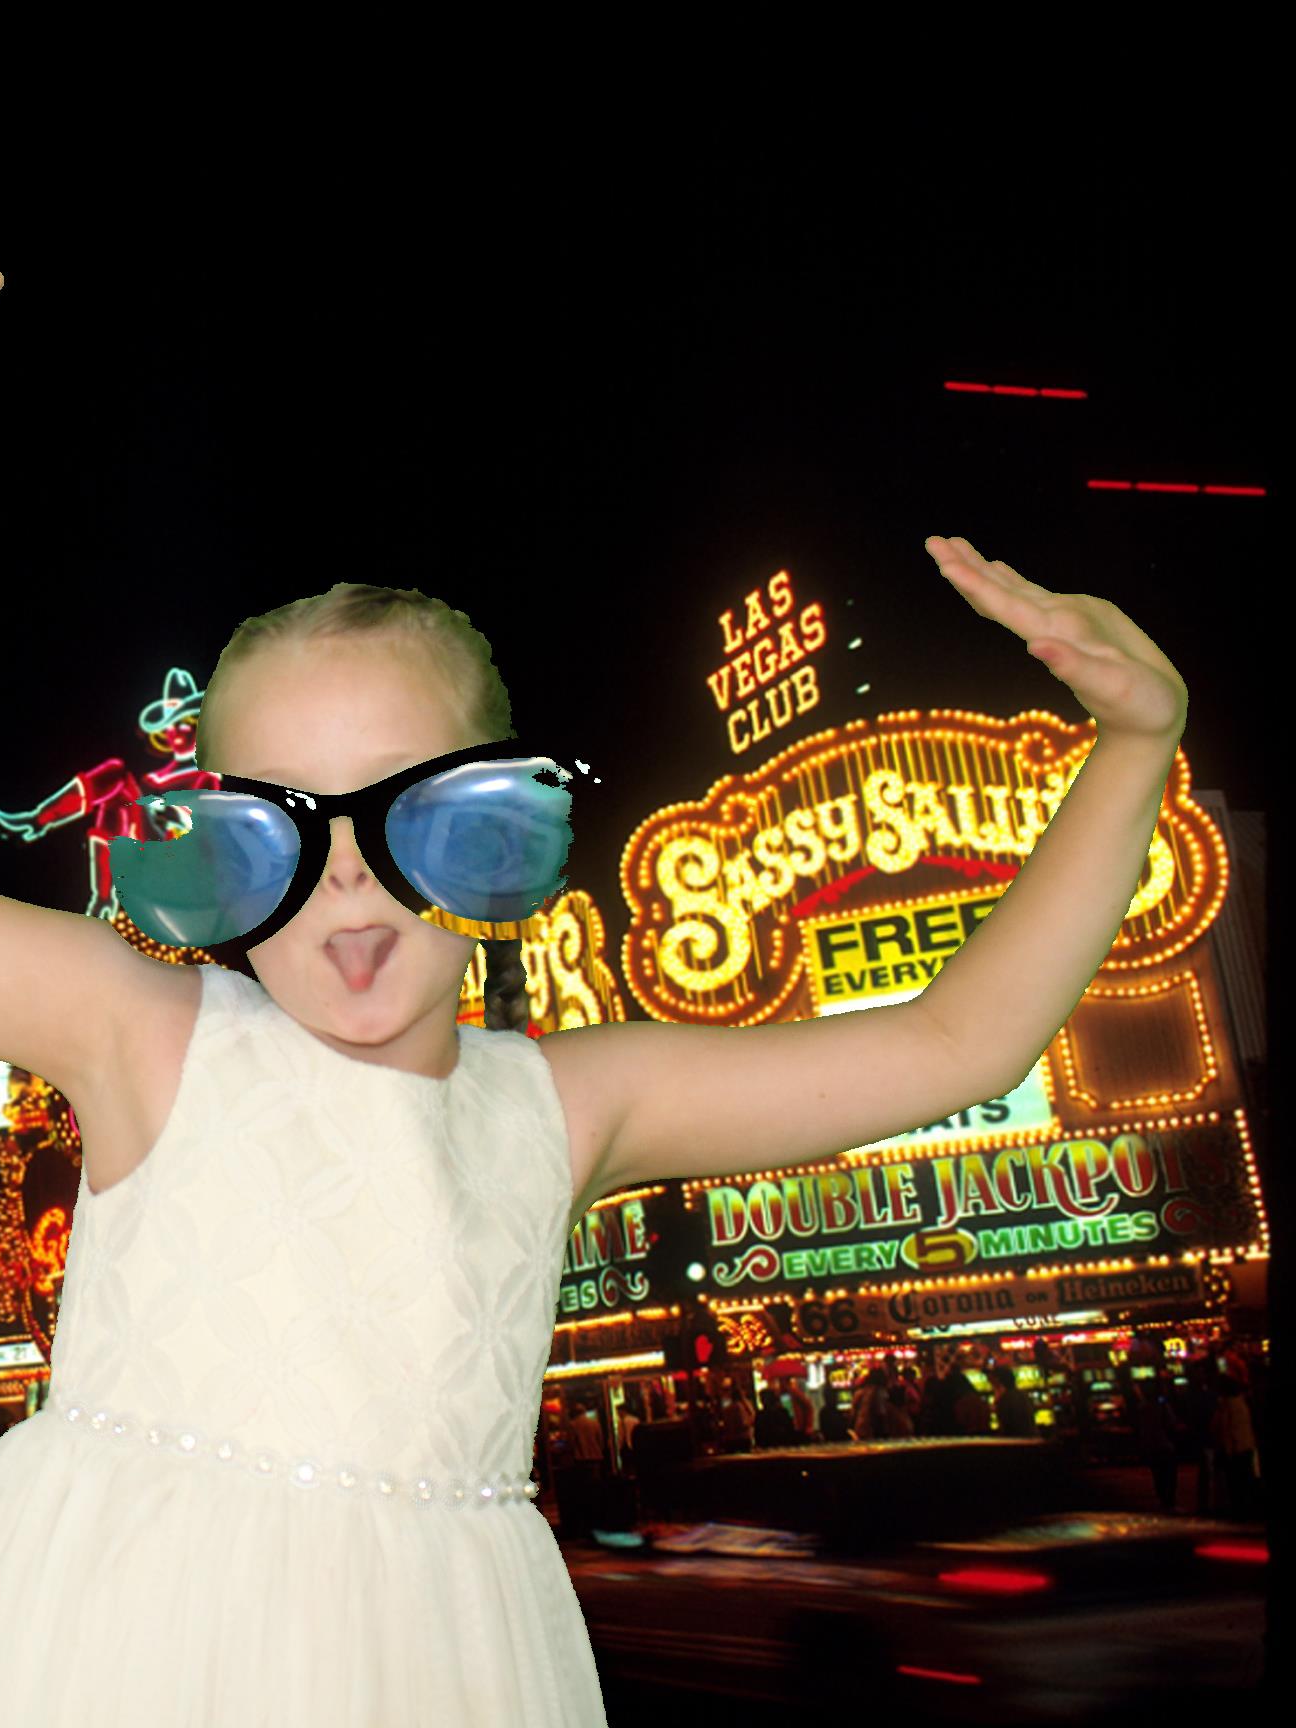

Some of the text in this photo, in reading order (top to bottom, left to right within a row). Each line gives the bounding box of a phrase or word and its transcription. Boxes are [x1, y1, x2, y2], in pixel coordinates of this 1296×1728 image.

[717, 569, 794, 655] LAS
[706, 602, 827, 711] VEGAS
[726, 664, 820, 755] CLUB
[656, 793, 858, 992] SASSY
[705, 1162, 923, 1246] DOUBLE
[781, 1210, 1160, 1281] EVERY 5 MINUTES
[1061, 1273, 1192, 1304] Heineken
